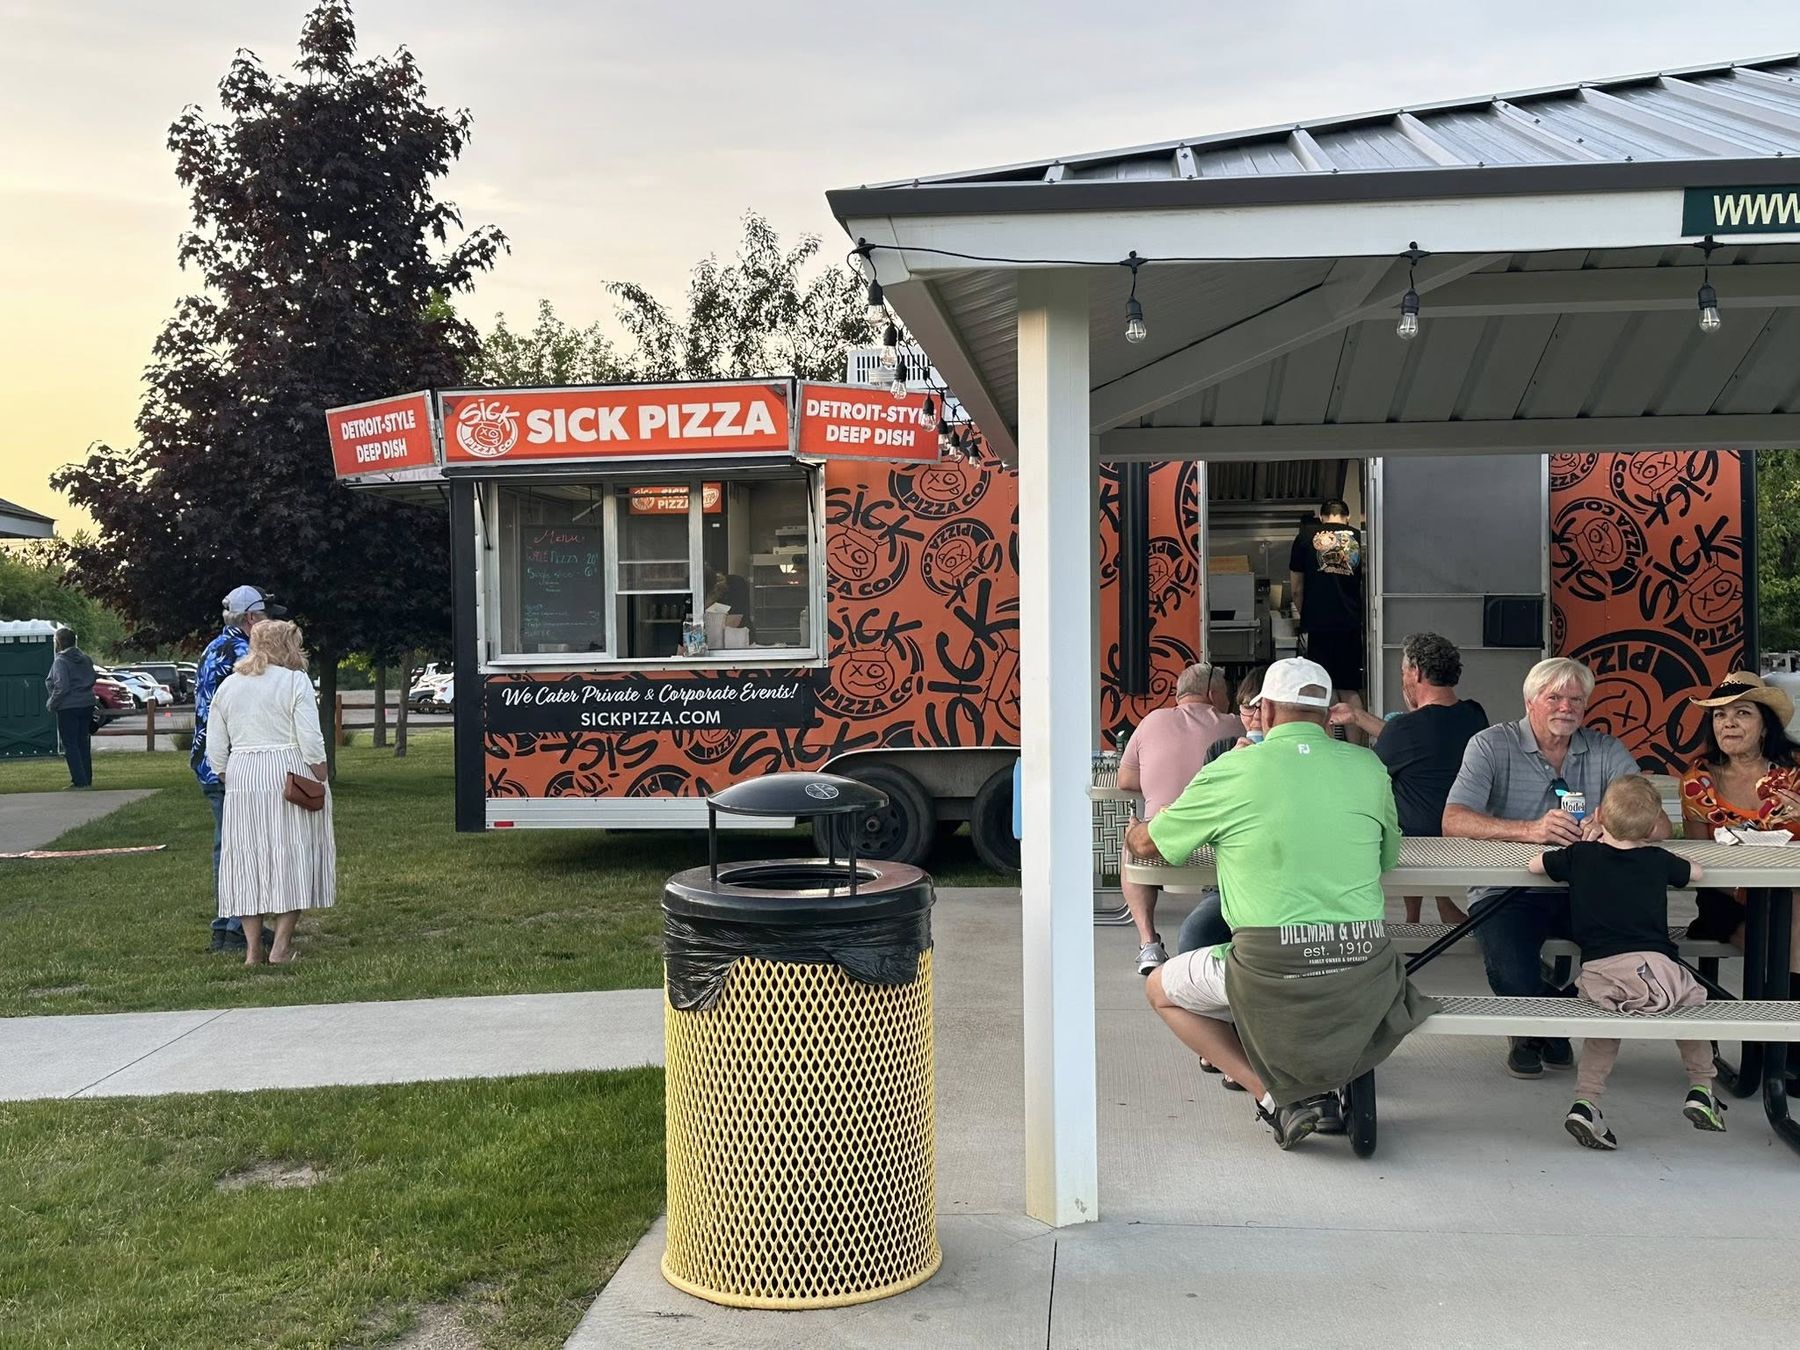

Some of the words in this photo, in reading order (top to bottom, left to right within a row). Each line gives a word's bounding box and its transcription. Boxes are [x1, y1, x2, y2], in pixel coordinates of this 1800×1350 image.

[526, 406, 630, 444] SICK
[638, 400, 777, 439] PIZZA
[806, 399, 937, 424] DETROIT-STYL
[340, 409, 416, 440] DETROIT-STYLE
[826, 424, 871, 444] DEEP
[874, 427, 915, 447] DISH
[356, 441, 383, 463] DEEP
[383, 438, 408, 460] DISH
[466, 438, 498, 456] PIZZA
[906, 491, 961, 516] PIZZA
[501, 686, 534, 706] We
[535, 686, 579, 706] Cater
[581, 685, 641, 704] Private
[644, 688, 655, 700] &
[658, 684, 738, 706] Corporate
[740, 682, 799, 701] Events!
[821, 688, 888, 714] PIZZA
[581, 710, 721, 727] SICKPIZZA.COM
[1280, 922, 1335, 945] DILLMAN
[1338, 922, 1349, 941] &
[1303, 945, 1330, 958] est.
[1339, 940, 1373, 955] 1910
